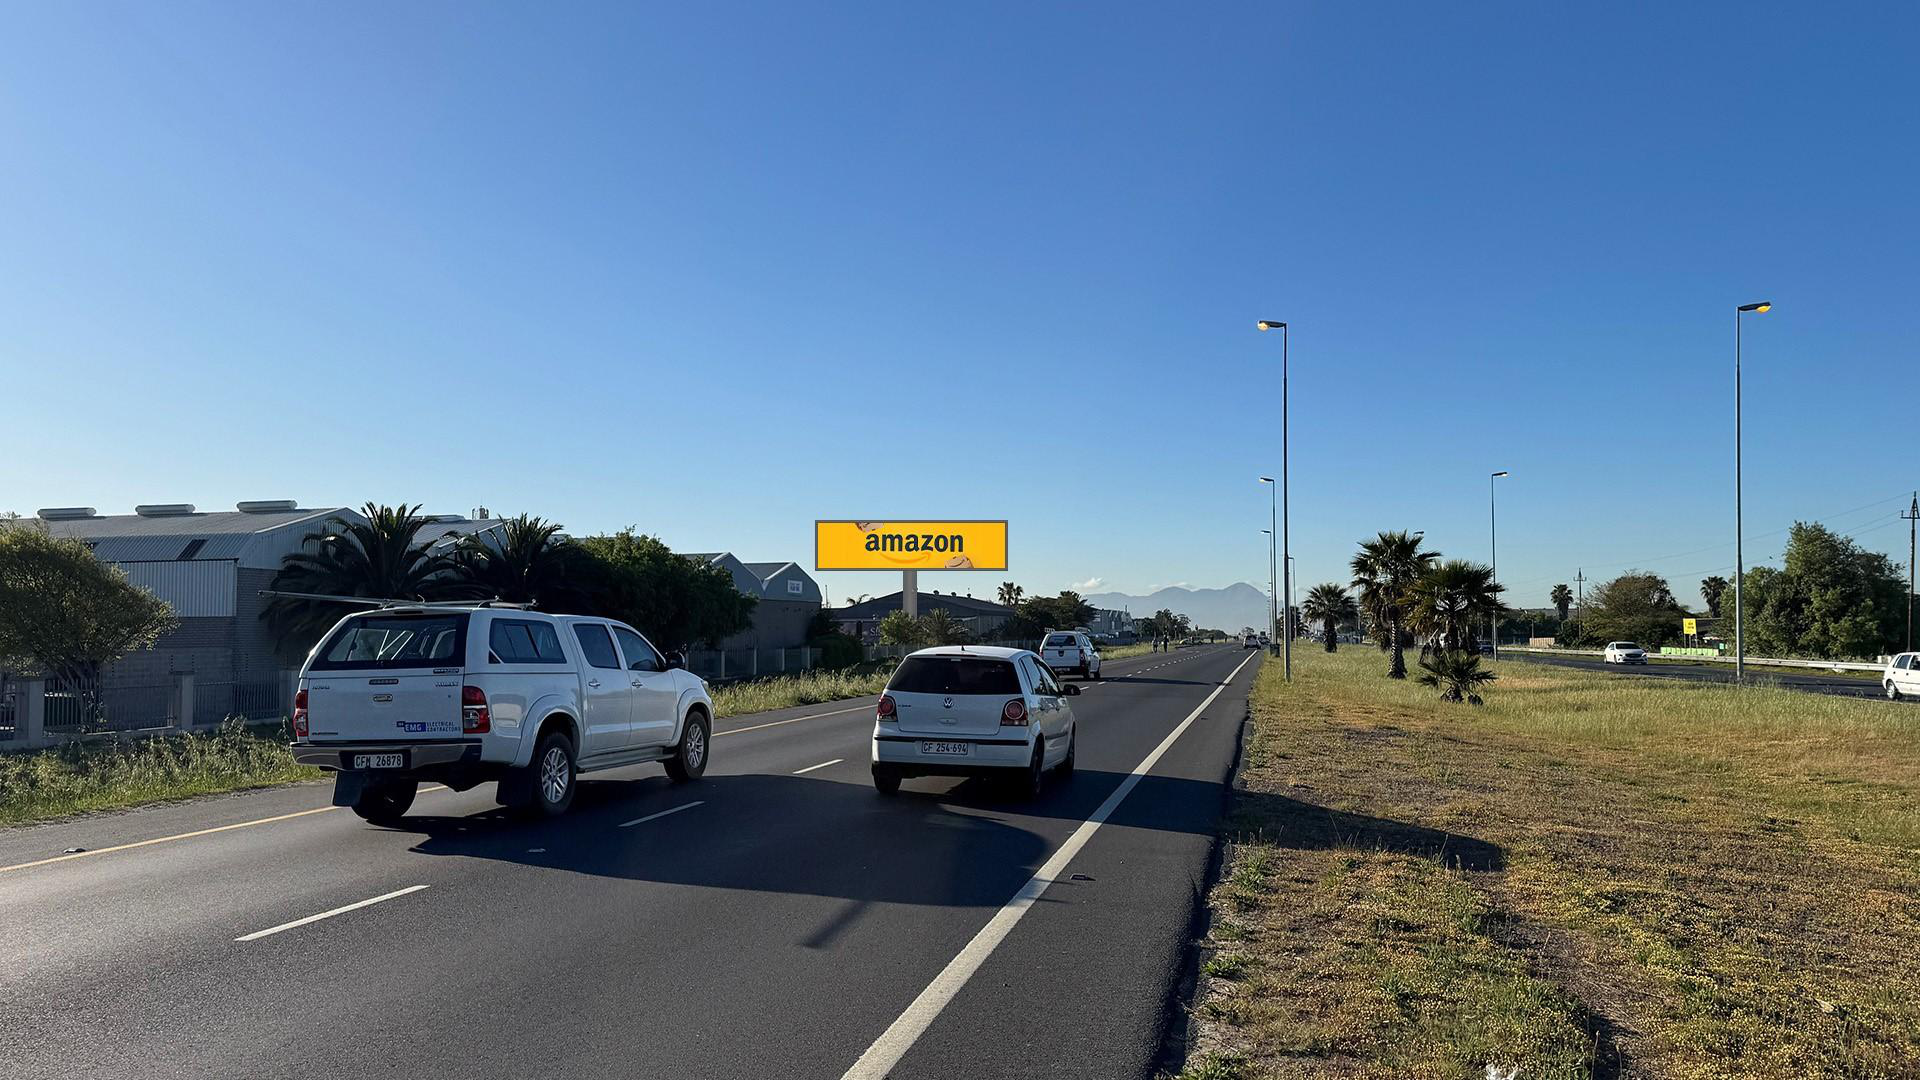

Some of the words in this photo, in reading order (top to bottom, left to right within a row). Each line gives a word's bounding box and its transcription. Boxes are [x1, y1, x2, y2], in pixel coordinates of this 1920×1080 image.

[865, 533, 964, 553] amazon
[405, 723, 422, 732] EMG
[923, 743, 933, 752] CF
[355, 756, 371, 767] CFM
[376, 755, 402, 767] 26878
